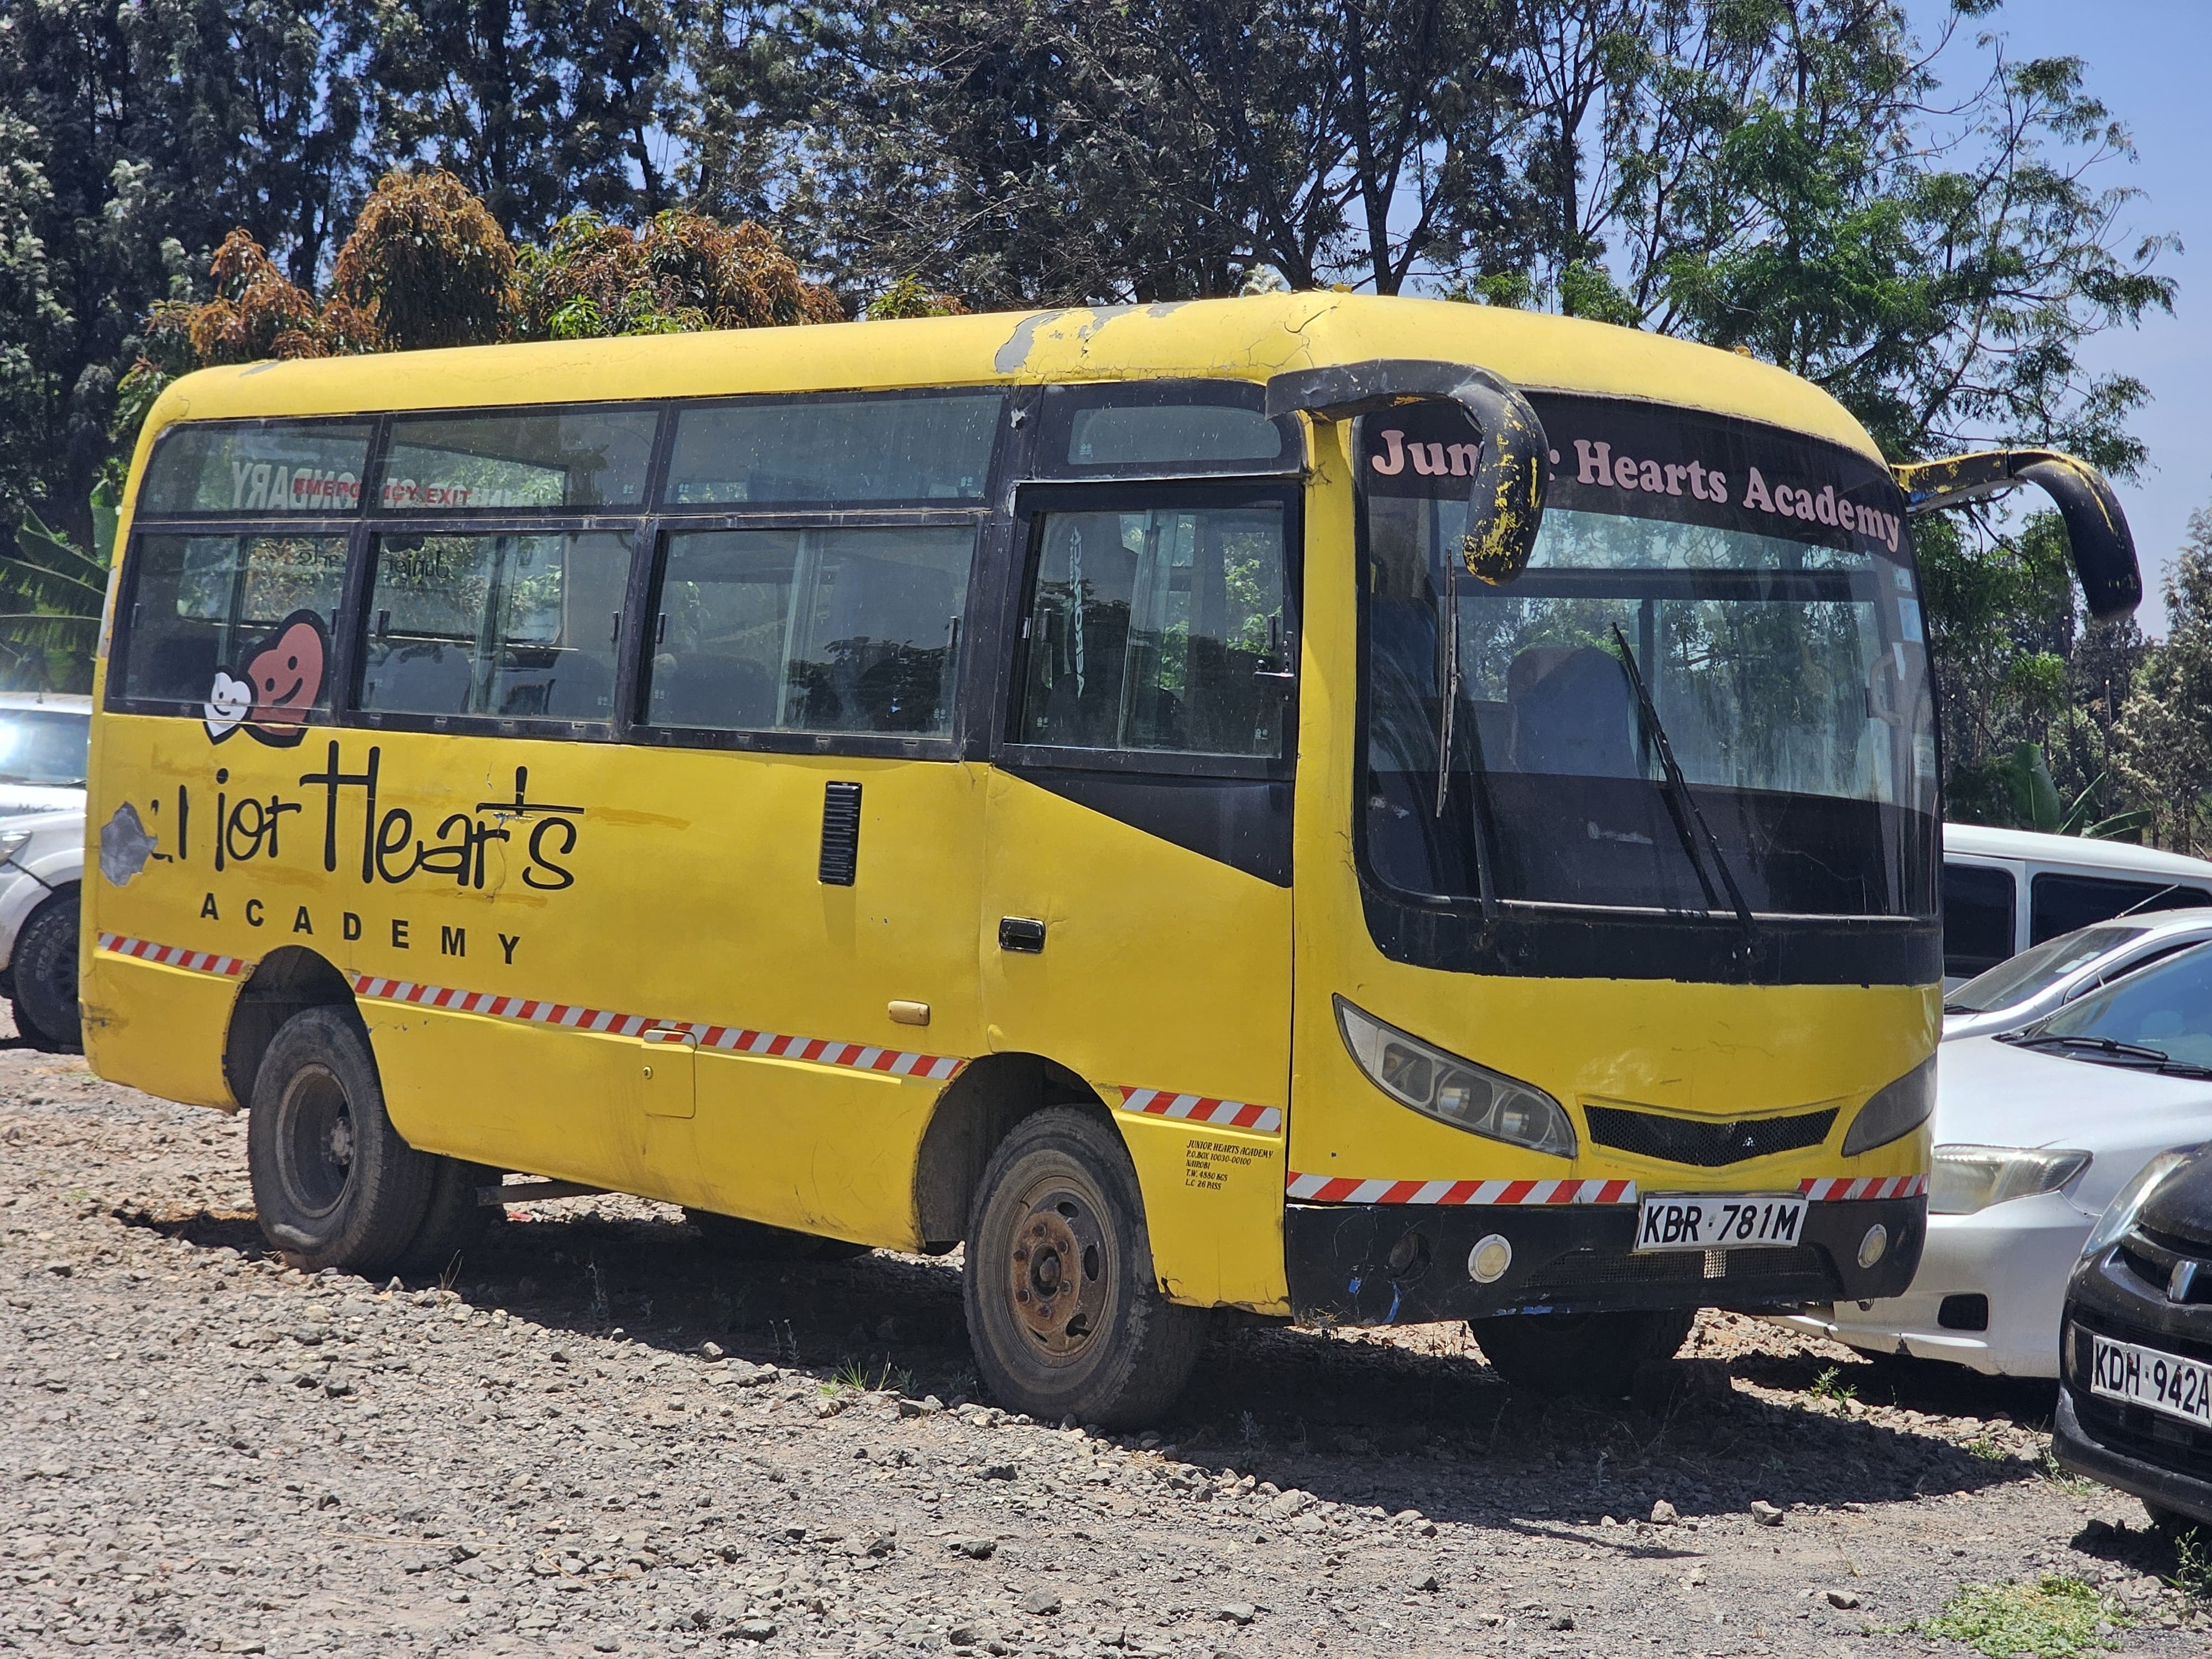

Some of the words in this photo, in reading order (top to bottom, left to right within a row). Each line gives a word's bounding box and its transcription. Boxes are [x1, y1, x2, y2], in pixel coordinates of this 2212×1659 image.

[293, 477, 420, 502] EMERGCY
[424, 488, 473, 506] EXIT
[1372, 430, 1561, 481] Jun
[1573, 439, 1728, 504] Hearts
[1743, 466, 1900, 552] Academy
[299, 740, 585, 890] Hearts
[200, 892, 521, 964] ACADEMY
[1186, 1139, 1213, 1150] JUNIOR
[1213, 1142, 1240, 1155] HEARTS
[1240, 1146, 1274, 1159] ACADEMY
[1211, 1153, 1251, 1165] 10030-00100
[1186, 1159, 1211, 1169] NAIROBI
[1199, 1171, 1216, 1180] 4880
[1216, 1173, 1228, 1182] KGS
[1207, 1181, 1222, 1191] PASS
[1643, 1205, 1702, 1243] KBR
[1717, 1204, 1801, 1241] 781M
[2095, 1343, 2141, 1396] KDH
[2153, 1359, 2210, 1419] 942A
